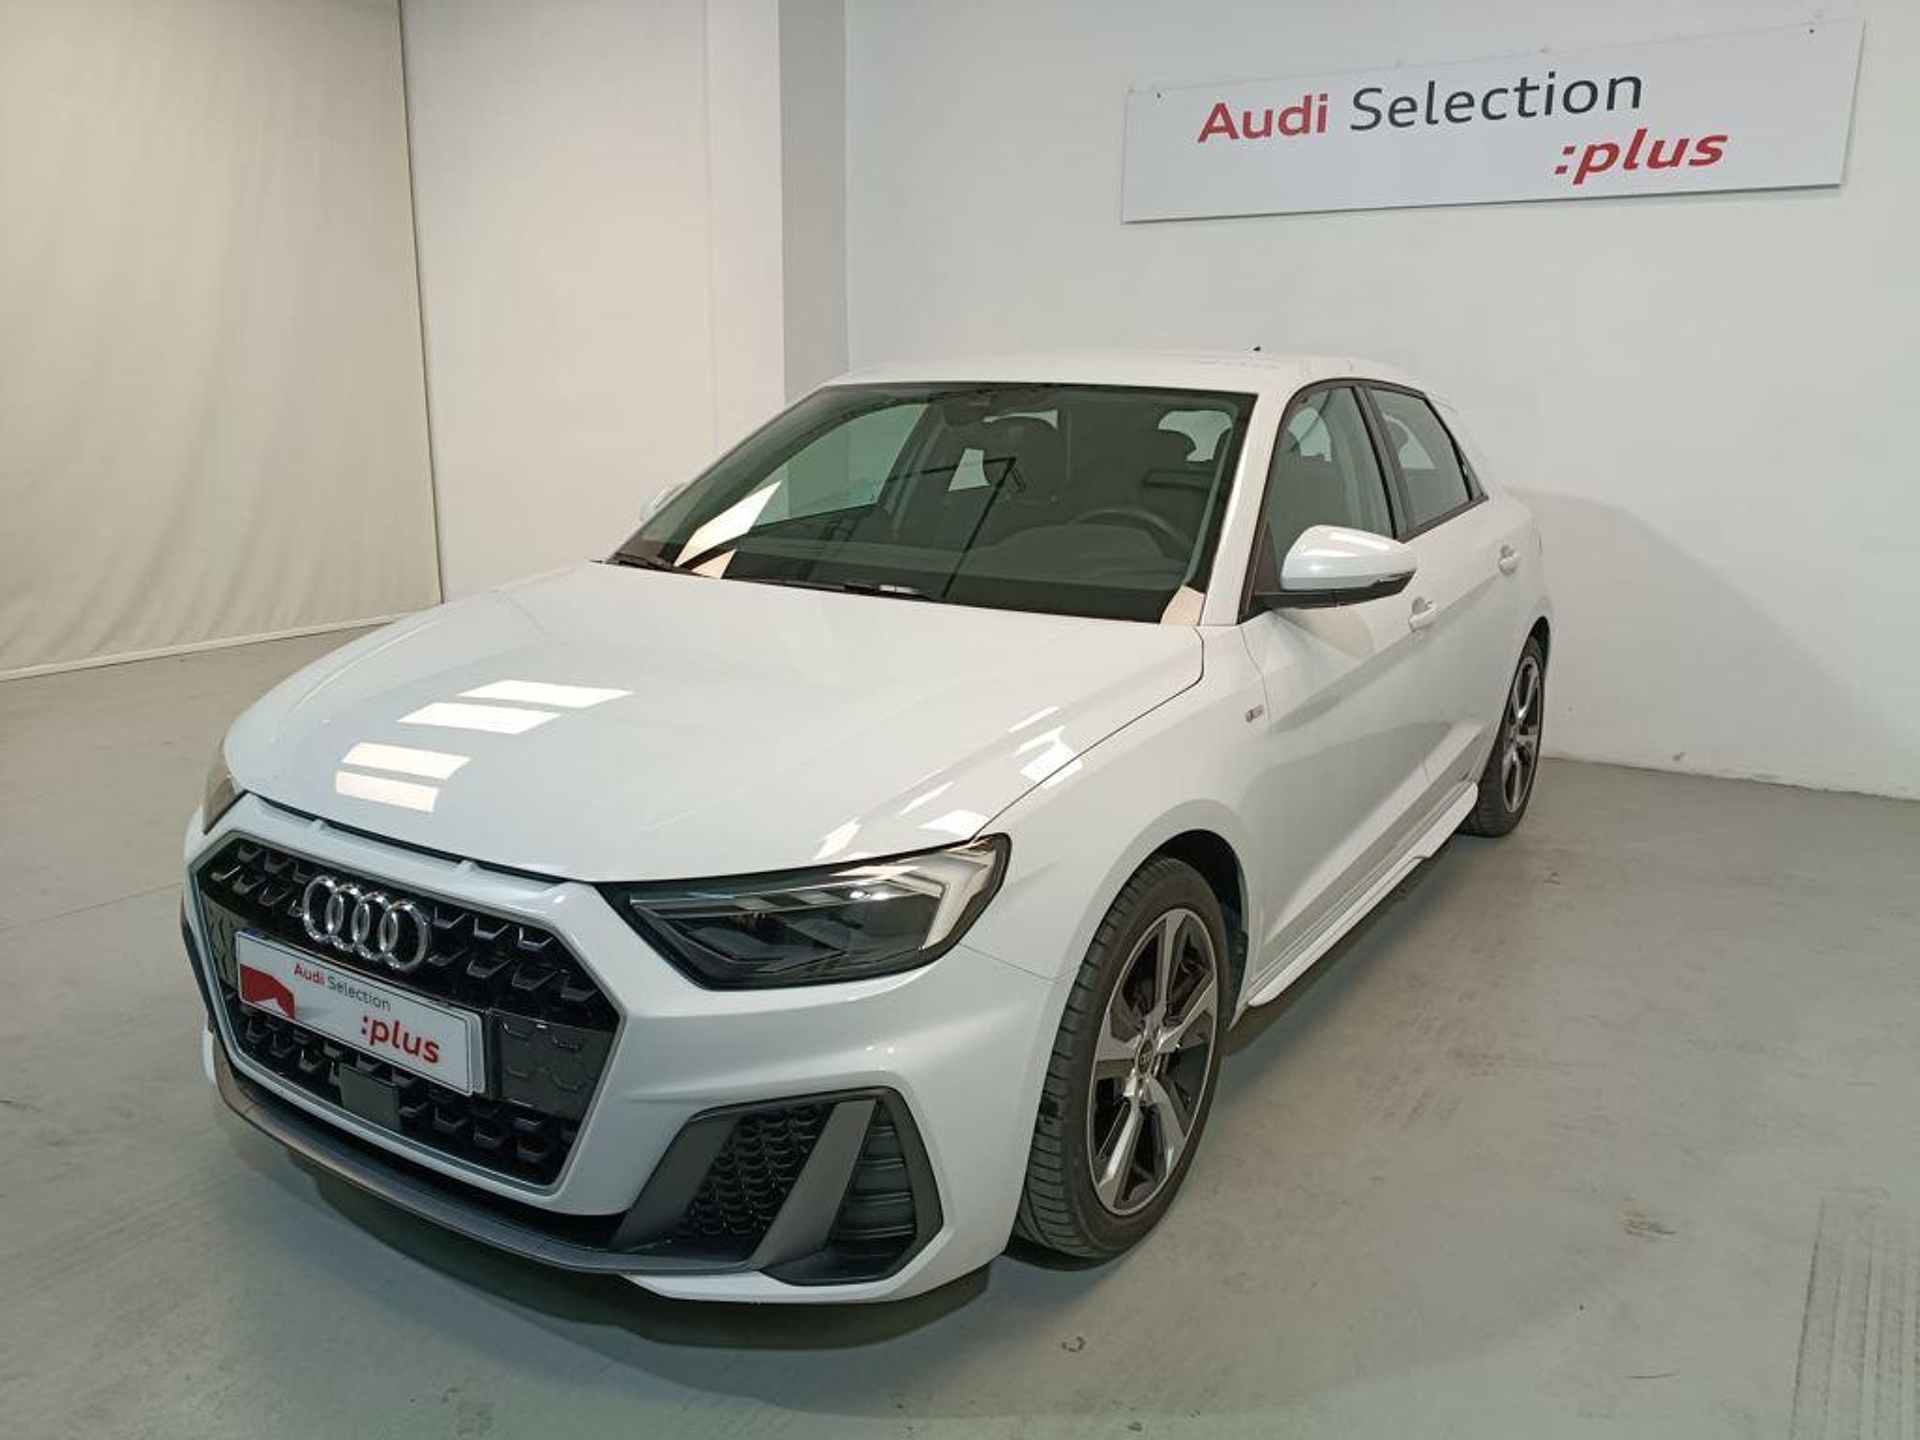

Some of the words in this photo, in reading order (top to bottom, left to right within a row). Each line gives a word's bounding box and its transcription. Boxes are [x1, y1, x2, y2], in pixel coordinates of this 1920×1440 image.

[1198, 94, 1328, 143] Audi
[1350, 71, 1642, 131] Selection
[293, 963, 325, 986] Audi
[328, 976, 391, 1012] Selection
